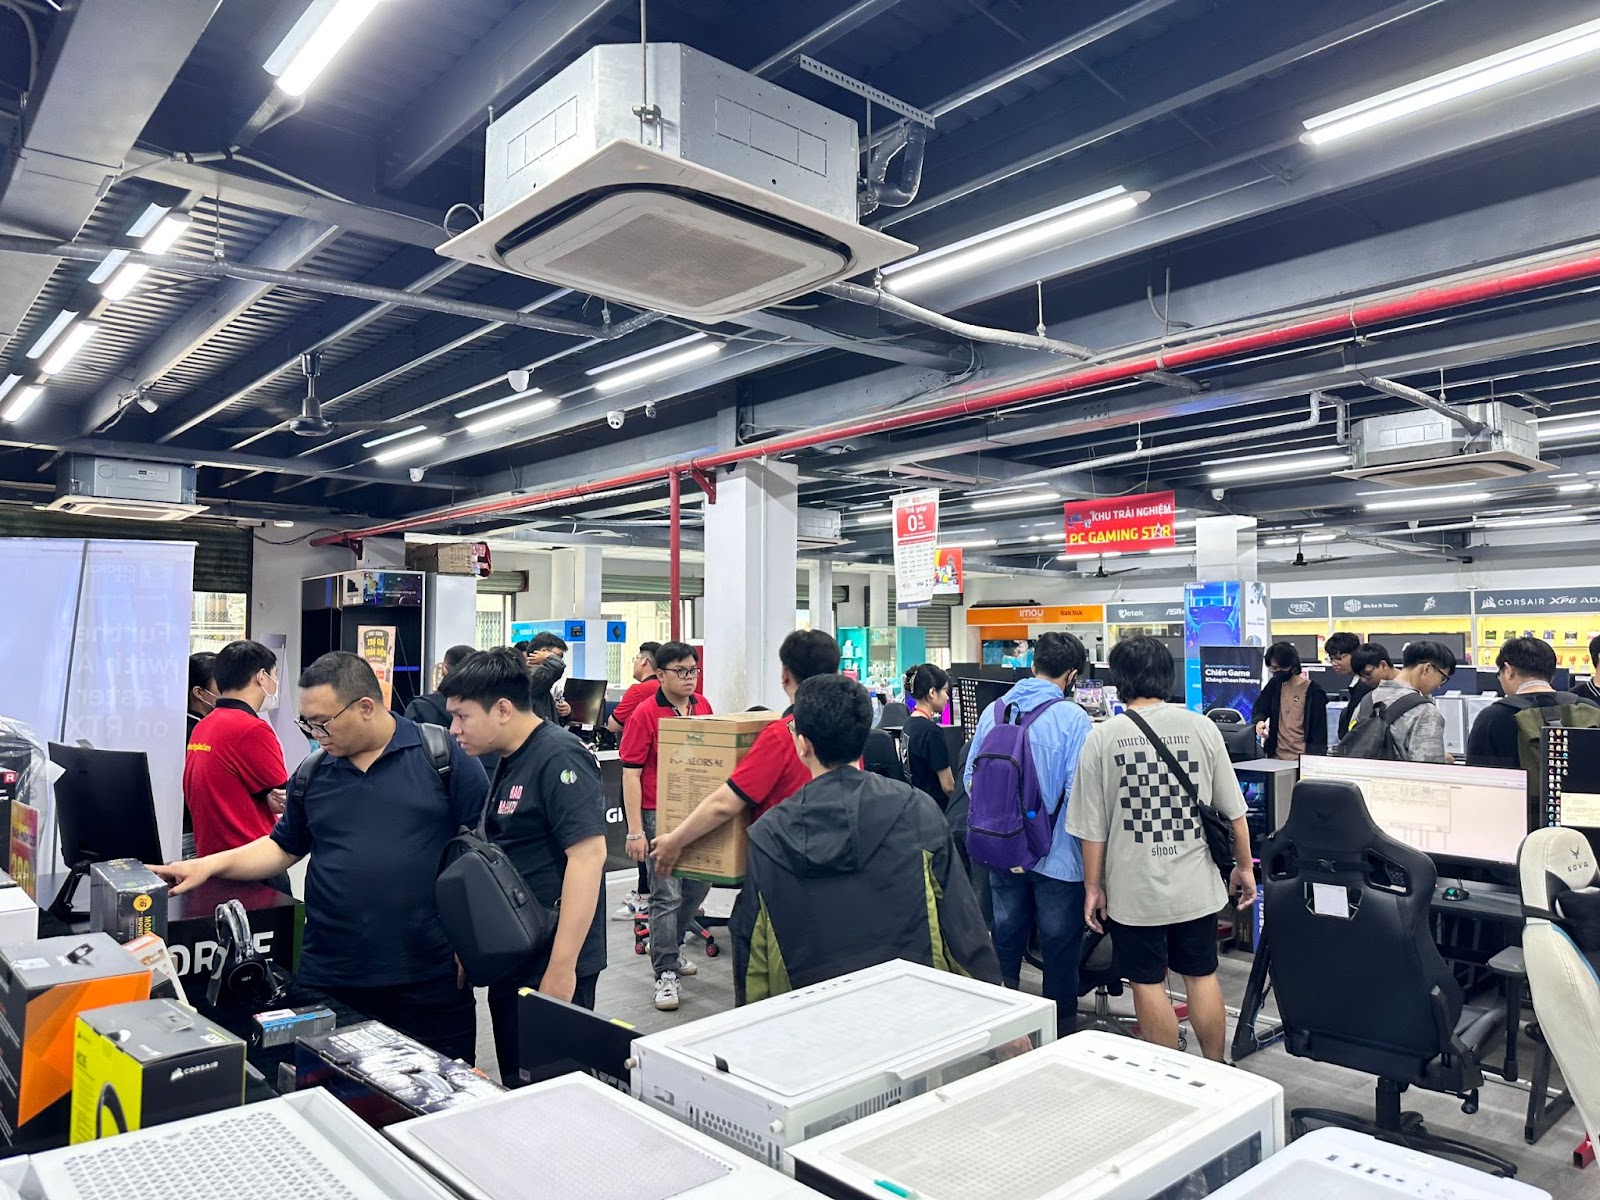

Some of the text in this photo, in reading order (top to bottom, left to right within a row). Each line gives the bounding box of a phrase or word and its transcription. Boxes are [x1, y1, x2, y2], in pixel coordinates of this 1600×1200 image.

[1091, 503, 1171, 522] KHU TRẢI NGHIỆM
[1070, 532, 1086, 544] PC
[1088, 528, 1139, 544] GAMING
[1497, 597, 1546, 606] CORSAIR
[1549, 595, 1578, 605] XPG
[1227, 669, 1251, 677] Game
[1117, 735, 1151, 748] murd
[1151, 843, 1178, 857] shoot
[183, 1061, 219, 1075] CORSAIR
